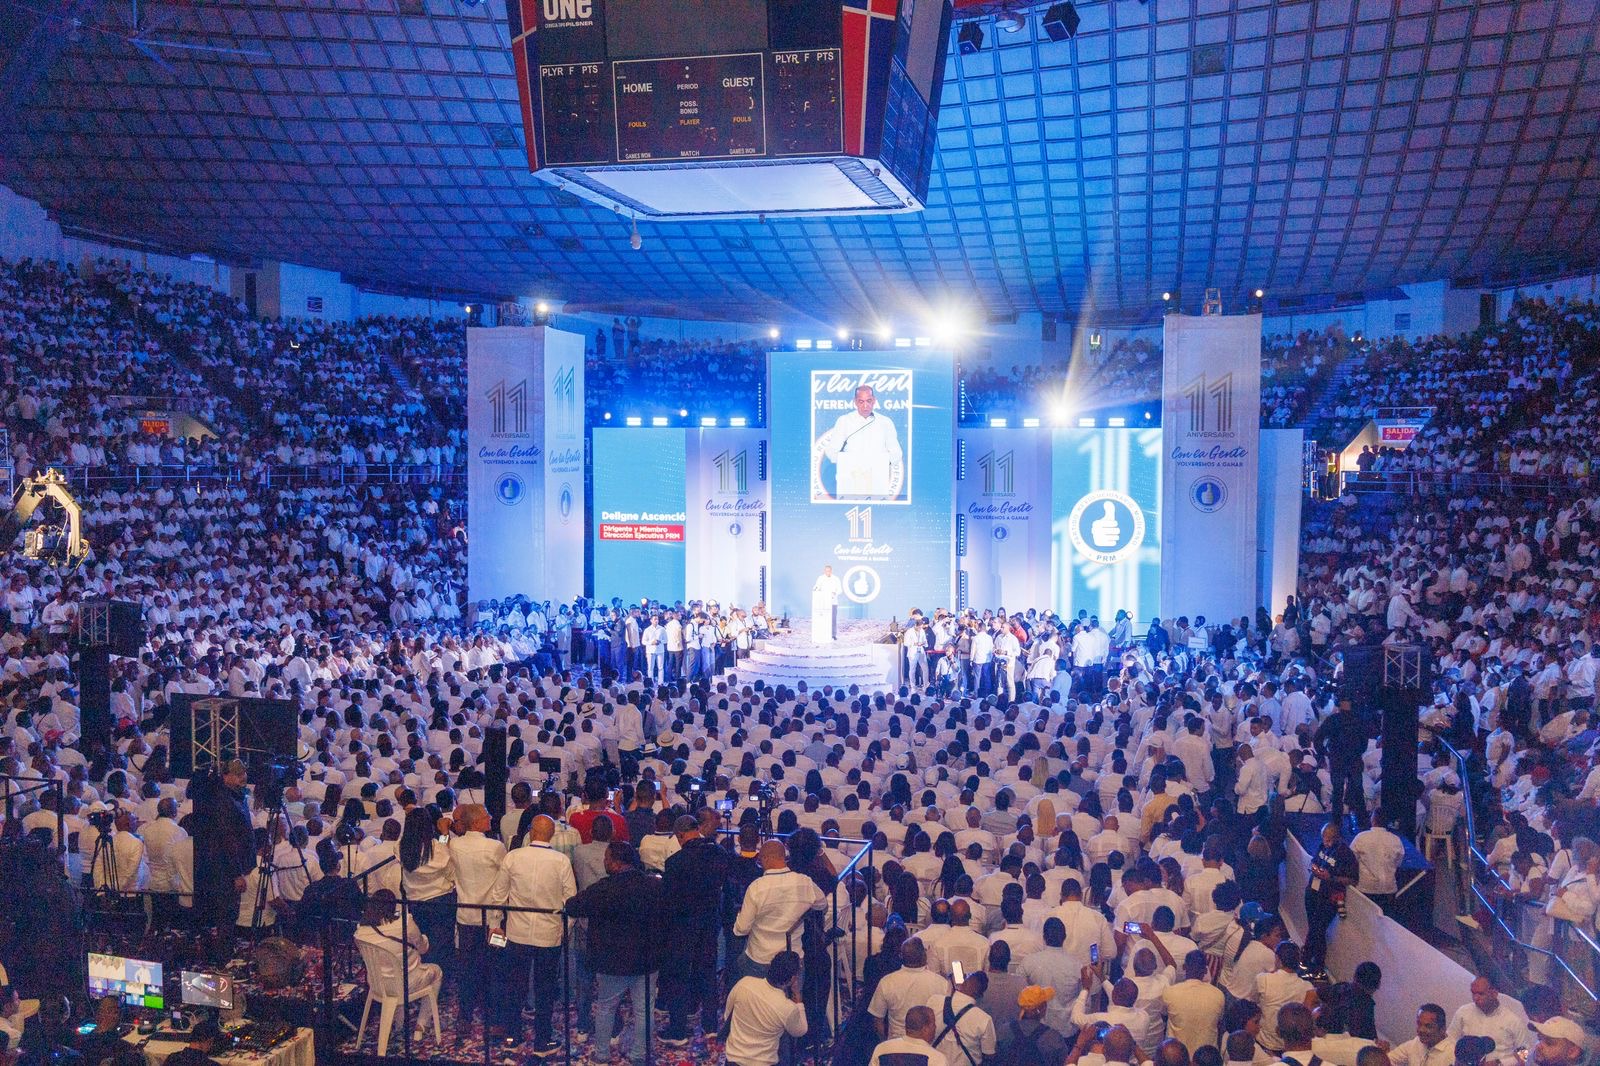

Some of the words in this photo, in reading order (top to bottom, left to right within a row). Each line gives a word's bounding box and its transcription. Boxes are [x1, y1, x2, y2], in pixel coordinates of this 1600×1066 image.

[776, 54, 798, 64] PLYR
[804, 53, 810, 62] F
[816, 52, 834, 61] PTS
[542, 66, 563, 76] PLYR
[569, 66, 574, 75] F
[582, 65, 598, 74] PTS
[623, 83, 653, 93] HOME
[722, 77, 755, 88] GUEST
[827, 374, 856, 392] la
[484, 378, 527, 432] 11
[1181, 370, 1232, 432] 11
[479, 446, 496, 458] Con
[509, 445, 541, 457] Gente
[1171, 446, 1193, 459] Con
[1193, 449, 1208, 458] la
[1209, 445, 1248, 460] Gente
[712, 450, 747, 490] 11
[977, 450, 1014, 492] 11
[706, 499, 721, 510] Con
[735, 498, 766, 510] Gente
[969, 502, 985, 513] Con
[1000, 501, 1033, 514] Gente
[602, 511, 639, 522] Deligne
[641, 512, 686, 521] Ascenció
[845, 505, 872, 538] 11
